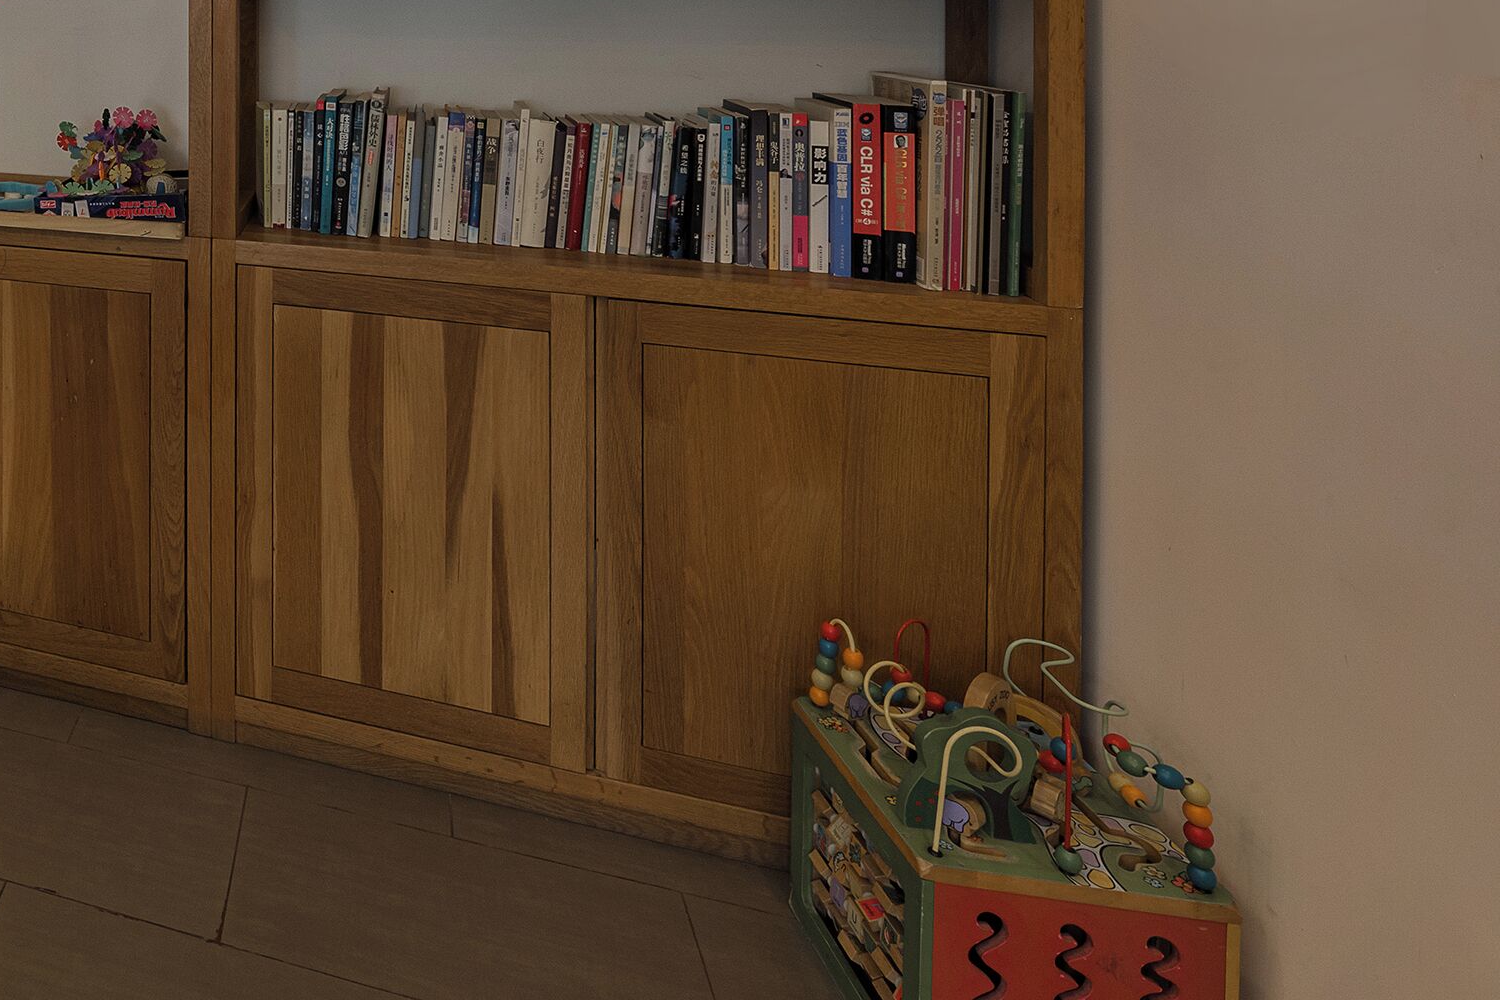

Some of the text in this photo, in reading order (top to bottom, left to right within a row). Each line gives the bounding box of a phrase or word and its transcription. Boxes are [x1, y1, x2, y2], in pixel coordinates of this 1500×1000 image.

[814, 148, 826, 183] 影响力
[860, 146, 873, 216] CLR via C#
